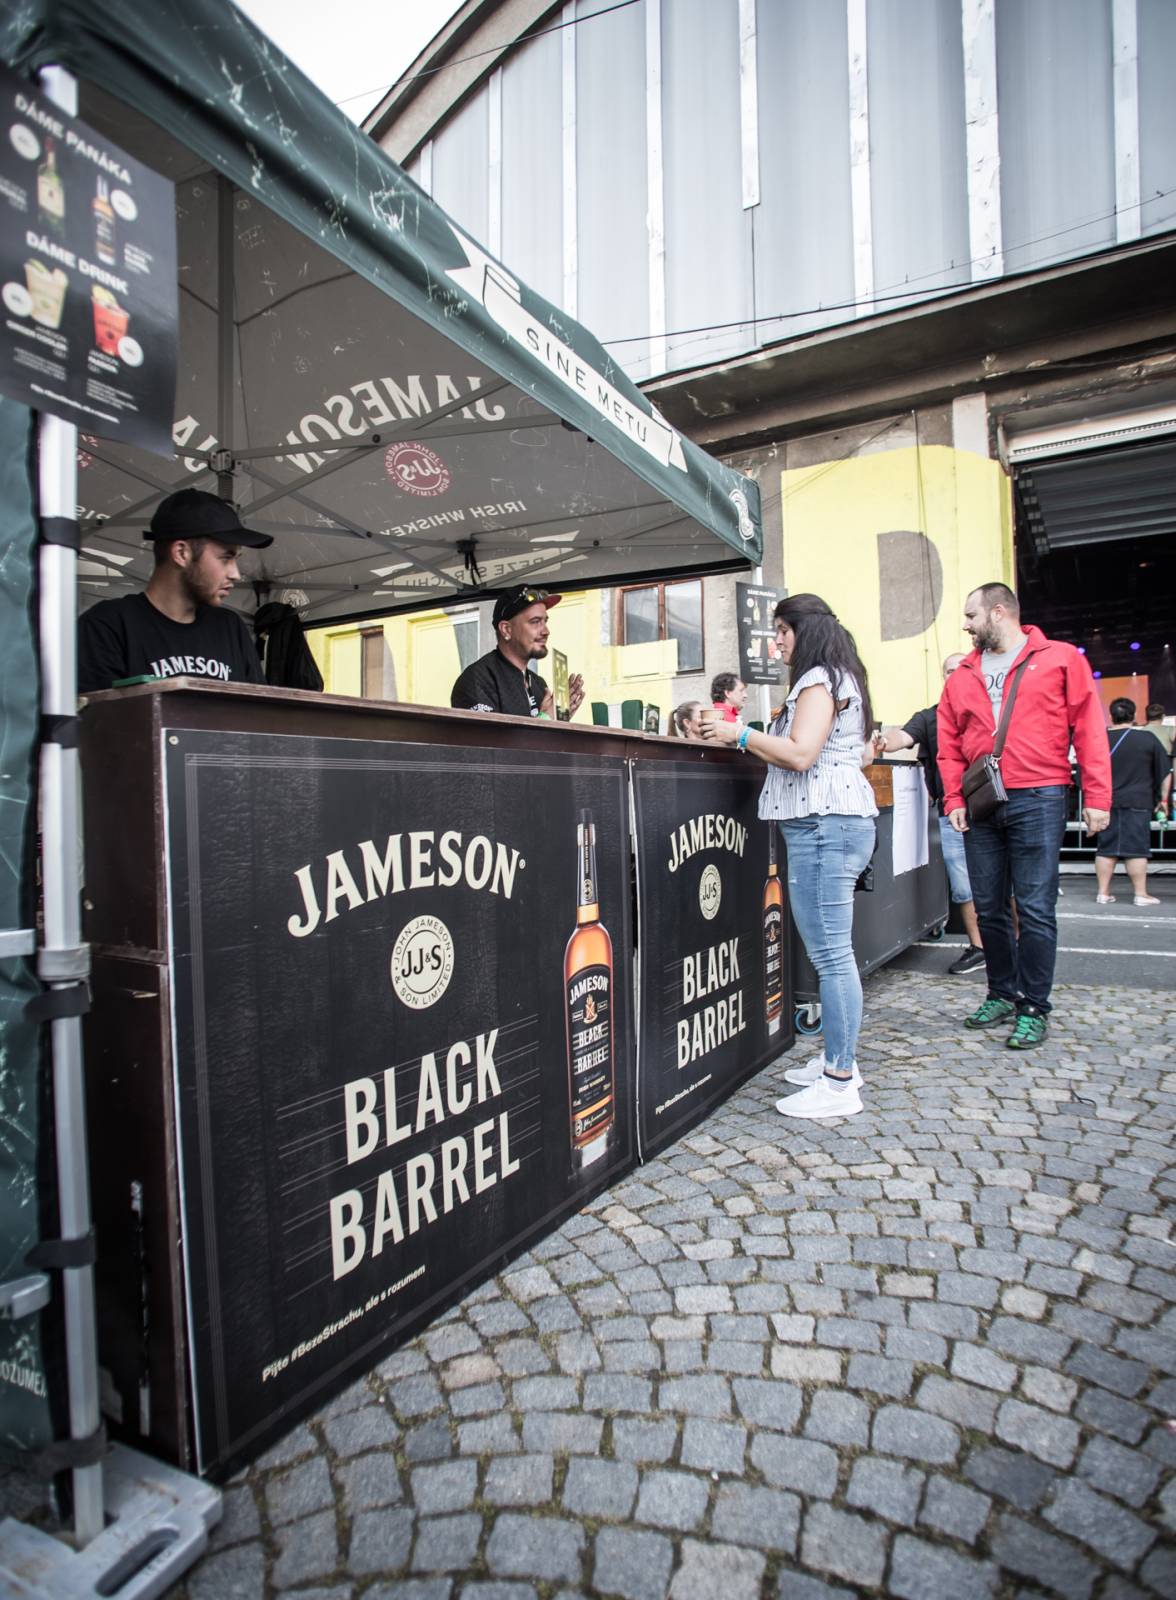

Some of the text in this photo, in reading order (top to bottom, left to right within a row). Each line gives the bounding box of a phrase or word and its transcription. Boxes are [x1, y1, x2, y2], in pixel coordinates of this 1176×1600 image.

[15, 93, 64, 139] DÁME
[26, 230, 76, 268] DÁME
[79, 257, 128, 296] DRINK
[526, 327, 648, 444] SINE METU
[149, 655, 229, 681] JAMESON
[668, 814, 746, 873] JAMESON
[287, 830, 521, 938] JAMESON
[394, 918, 452, 963] JOHN JAMESON
[401, 945, 442, 978] JJ&S
[400, 987, 418, 1005] SON
[422, 963, 452, 1005] LIMITED
[569, 975, 609, 1006] JAMESON
[683, 937, 741, 1005] BLACK
[677, 990, 747, 1069] BARREL
[344, 1028, 502, 1165] BLACK
[329, 1111, 520, 1281] BARREL
[0, 1358, 47, 1398] OZUME
